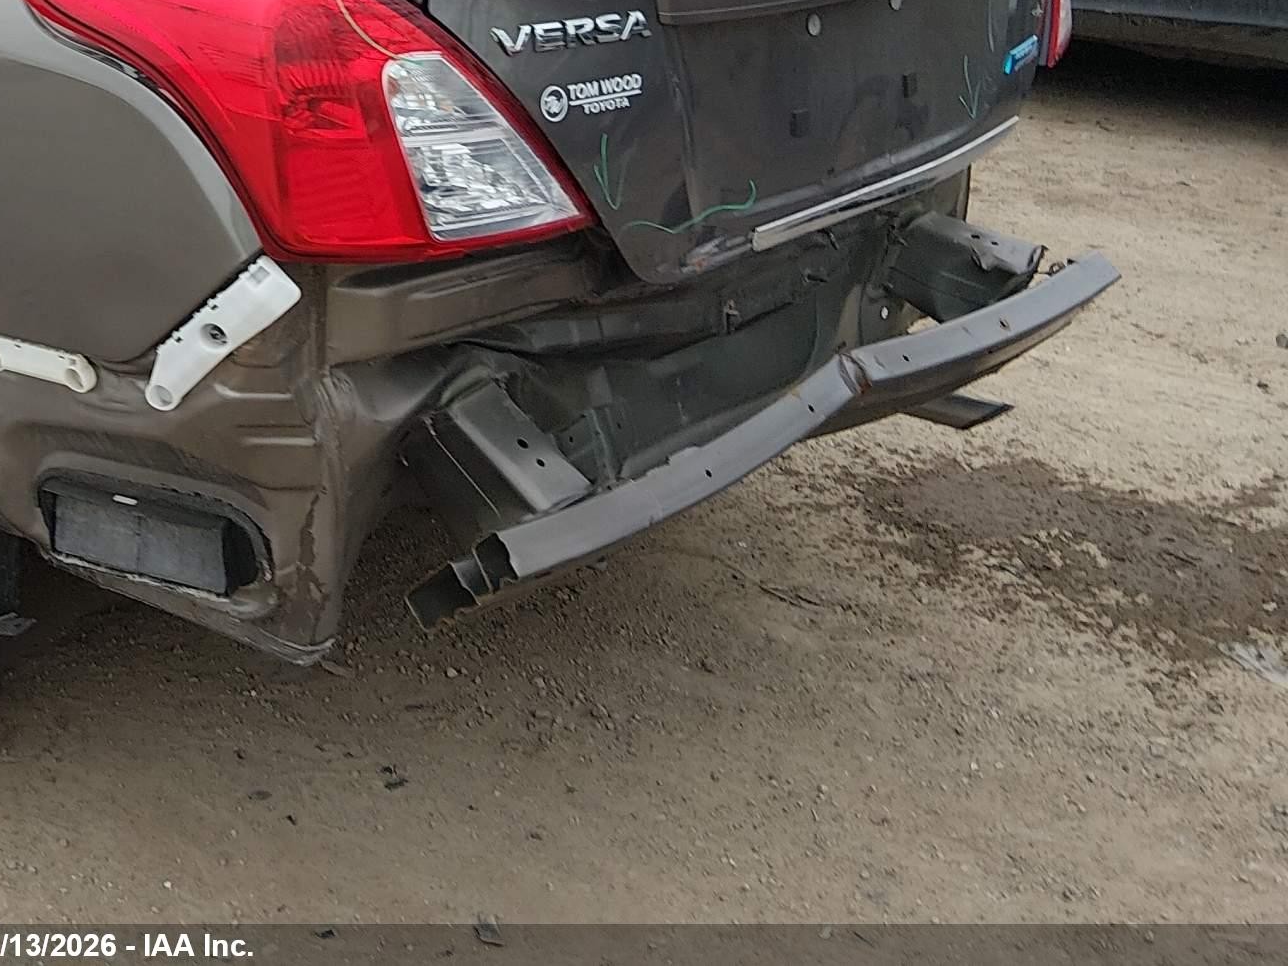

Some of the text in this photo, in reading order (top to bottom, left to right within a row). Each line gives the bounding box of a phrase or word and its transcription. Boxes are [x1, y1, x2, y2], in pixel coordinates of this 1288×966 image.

[490, 10, 652, 56] VERSA
[567, 73, 642, 100] TOM WOOD
[582, 97, 630, 114] TOYOTA
